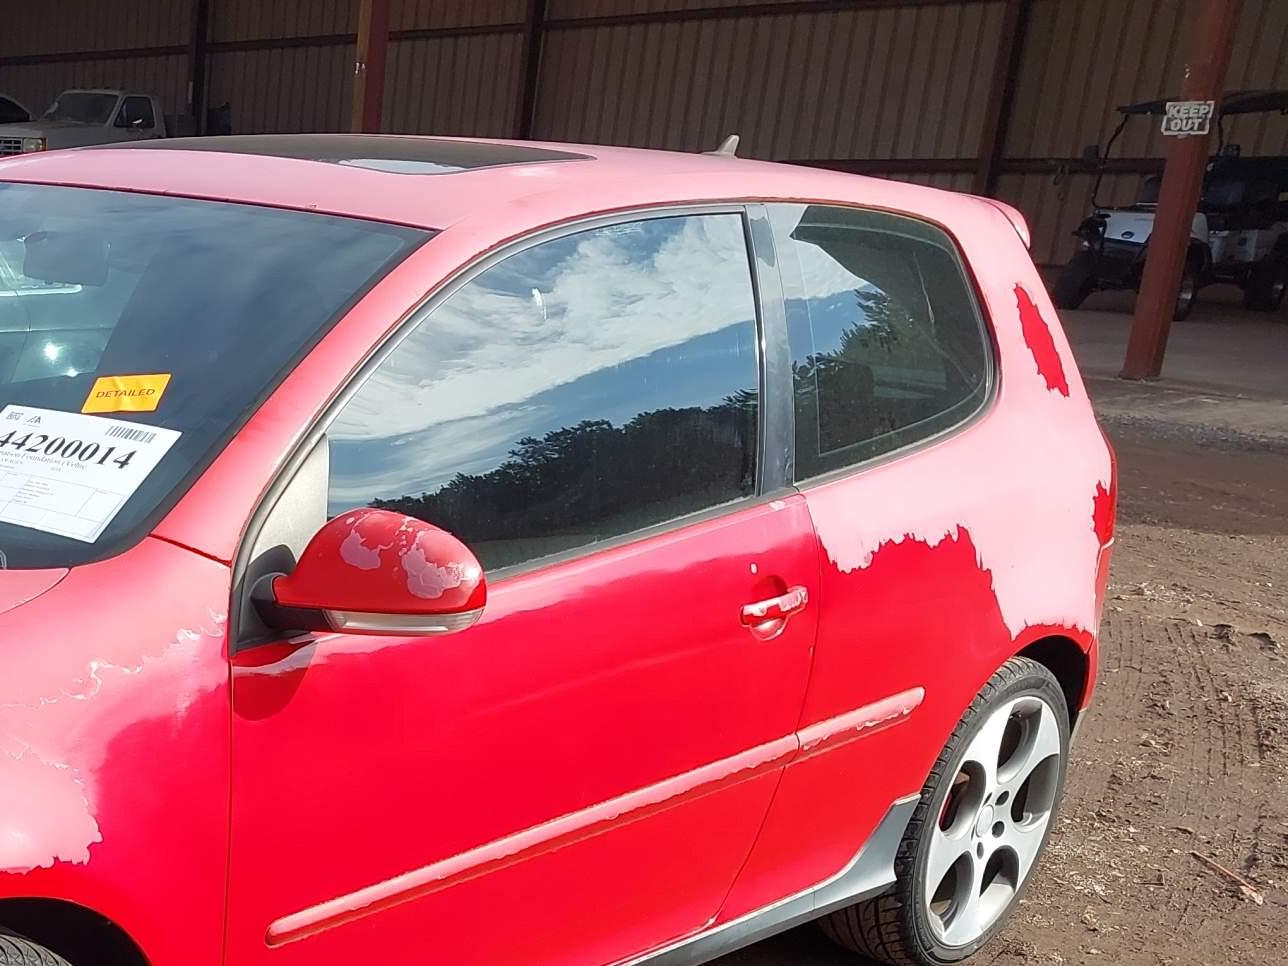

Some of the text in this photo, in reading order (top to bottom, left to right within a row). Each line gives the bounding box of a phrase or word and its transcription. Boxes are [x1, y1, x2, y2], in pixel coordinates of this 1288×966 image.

[1169, 104, 1210, 118] KEEP
[1170, 118, 1203, 131] OUT
[95, 387, 156, 399] DETAILED
